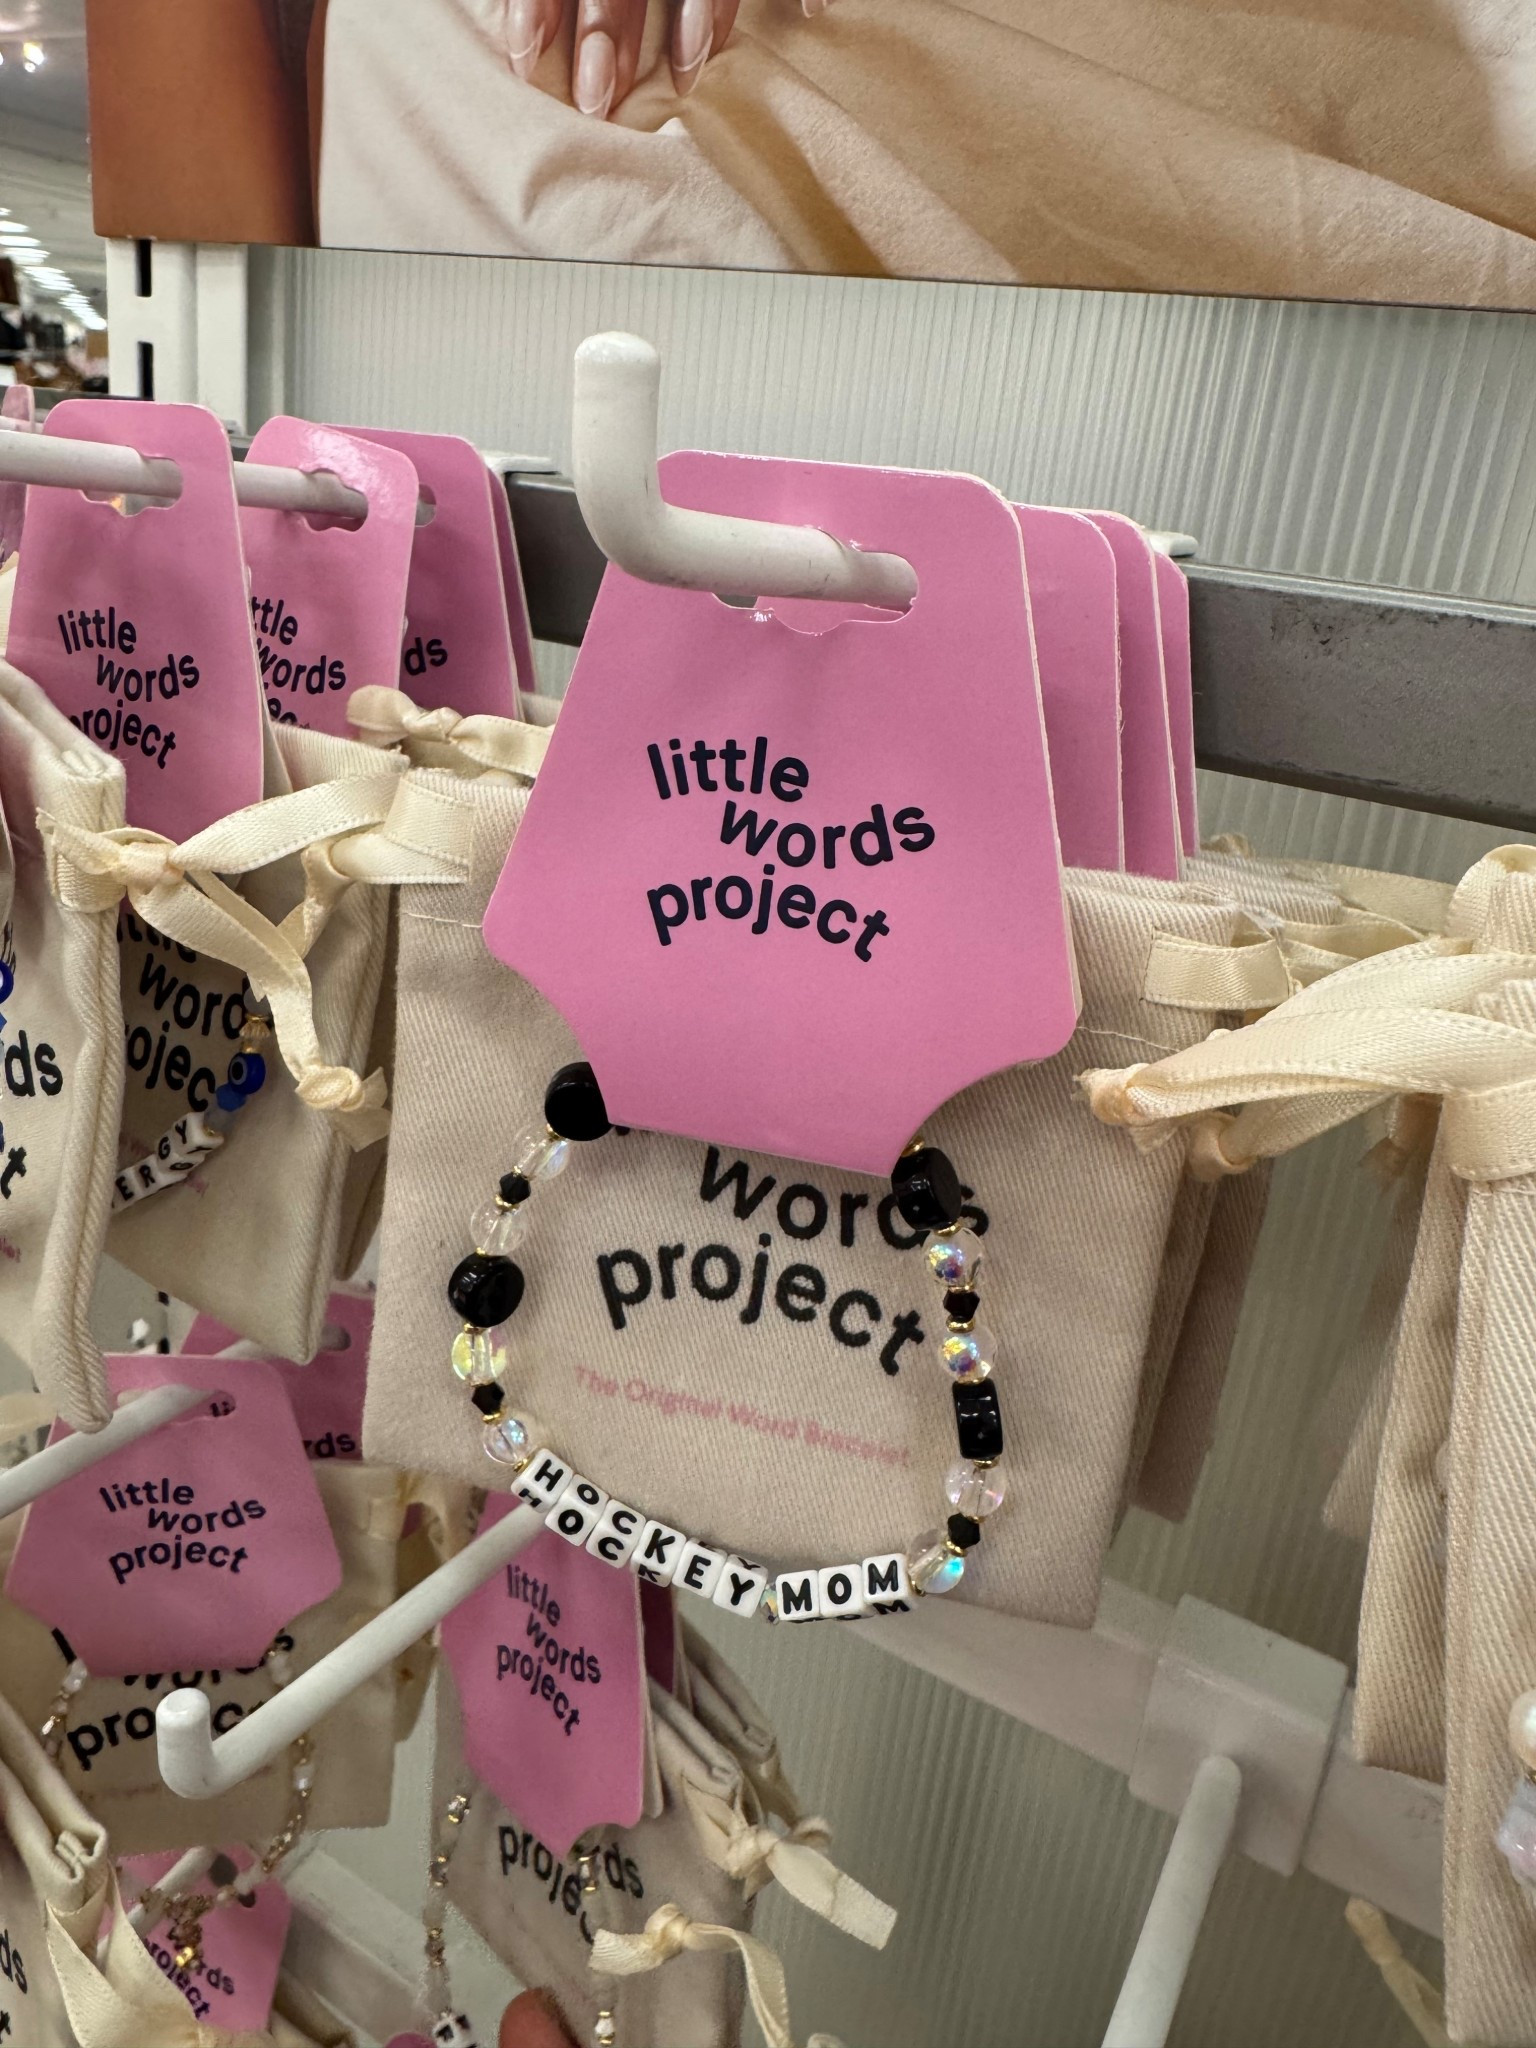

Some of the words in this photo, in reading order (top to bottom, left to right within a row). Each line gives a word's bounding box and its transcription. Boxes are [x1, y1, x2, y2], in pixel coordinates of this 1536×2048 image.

[58, 606, 137, 655] little
[97, 653, 200, 703] words
[646, 736, 810, 803] little
[719, 800, 936, 870] words
[646, 863, 890, 963] project
[139, 952, 252, 1041] word
[597, 1233, 926, 1377] project
[99, 1477, 195, 1513] little
[147, 1498, 267, 1535] words
[108, 1534, 249, 1585] project
[530, 1458, 757, 1608] HOCKEY
[780, 1559, 901, 1616] MOM
[506, 1563, 562, 1628] little
[526, 1612, 602, 1685] words
[497, 1644, 581, 1737] project
